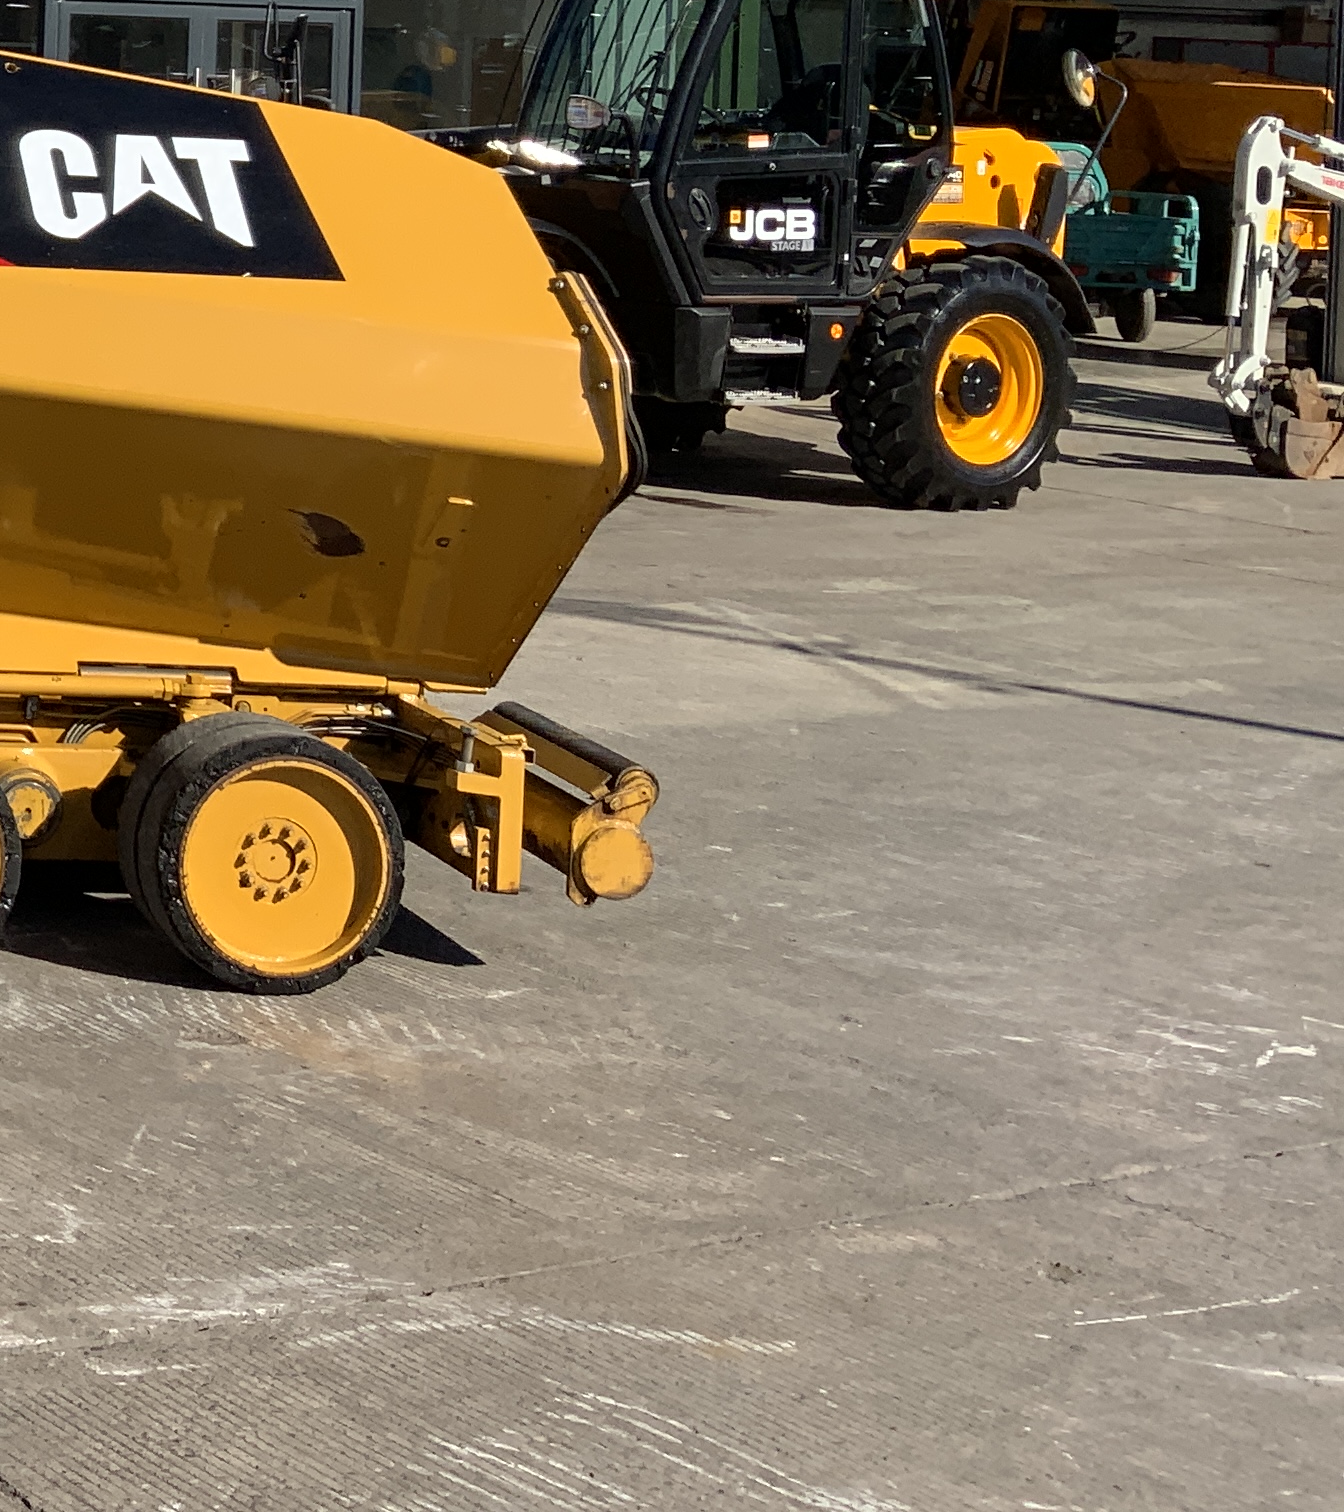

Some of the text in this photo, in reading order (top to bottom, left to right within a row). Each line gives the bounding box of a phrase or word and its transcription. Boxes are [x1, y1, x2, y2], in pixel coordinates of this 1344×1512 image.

[19, 129, 256, 248] CAT
[729, 209, 816, 241] JCB
[771, 240, 801, 251] STAGE
